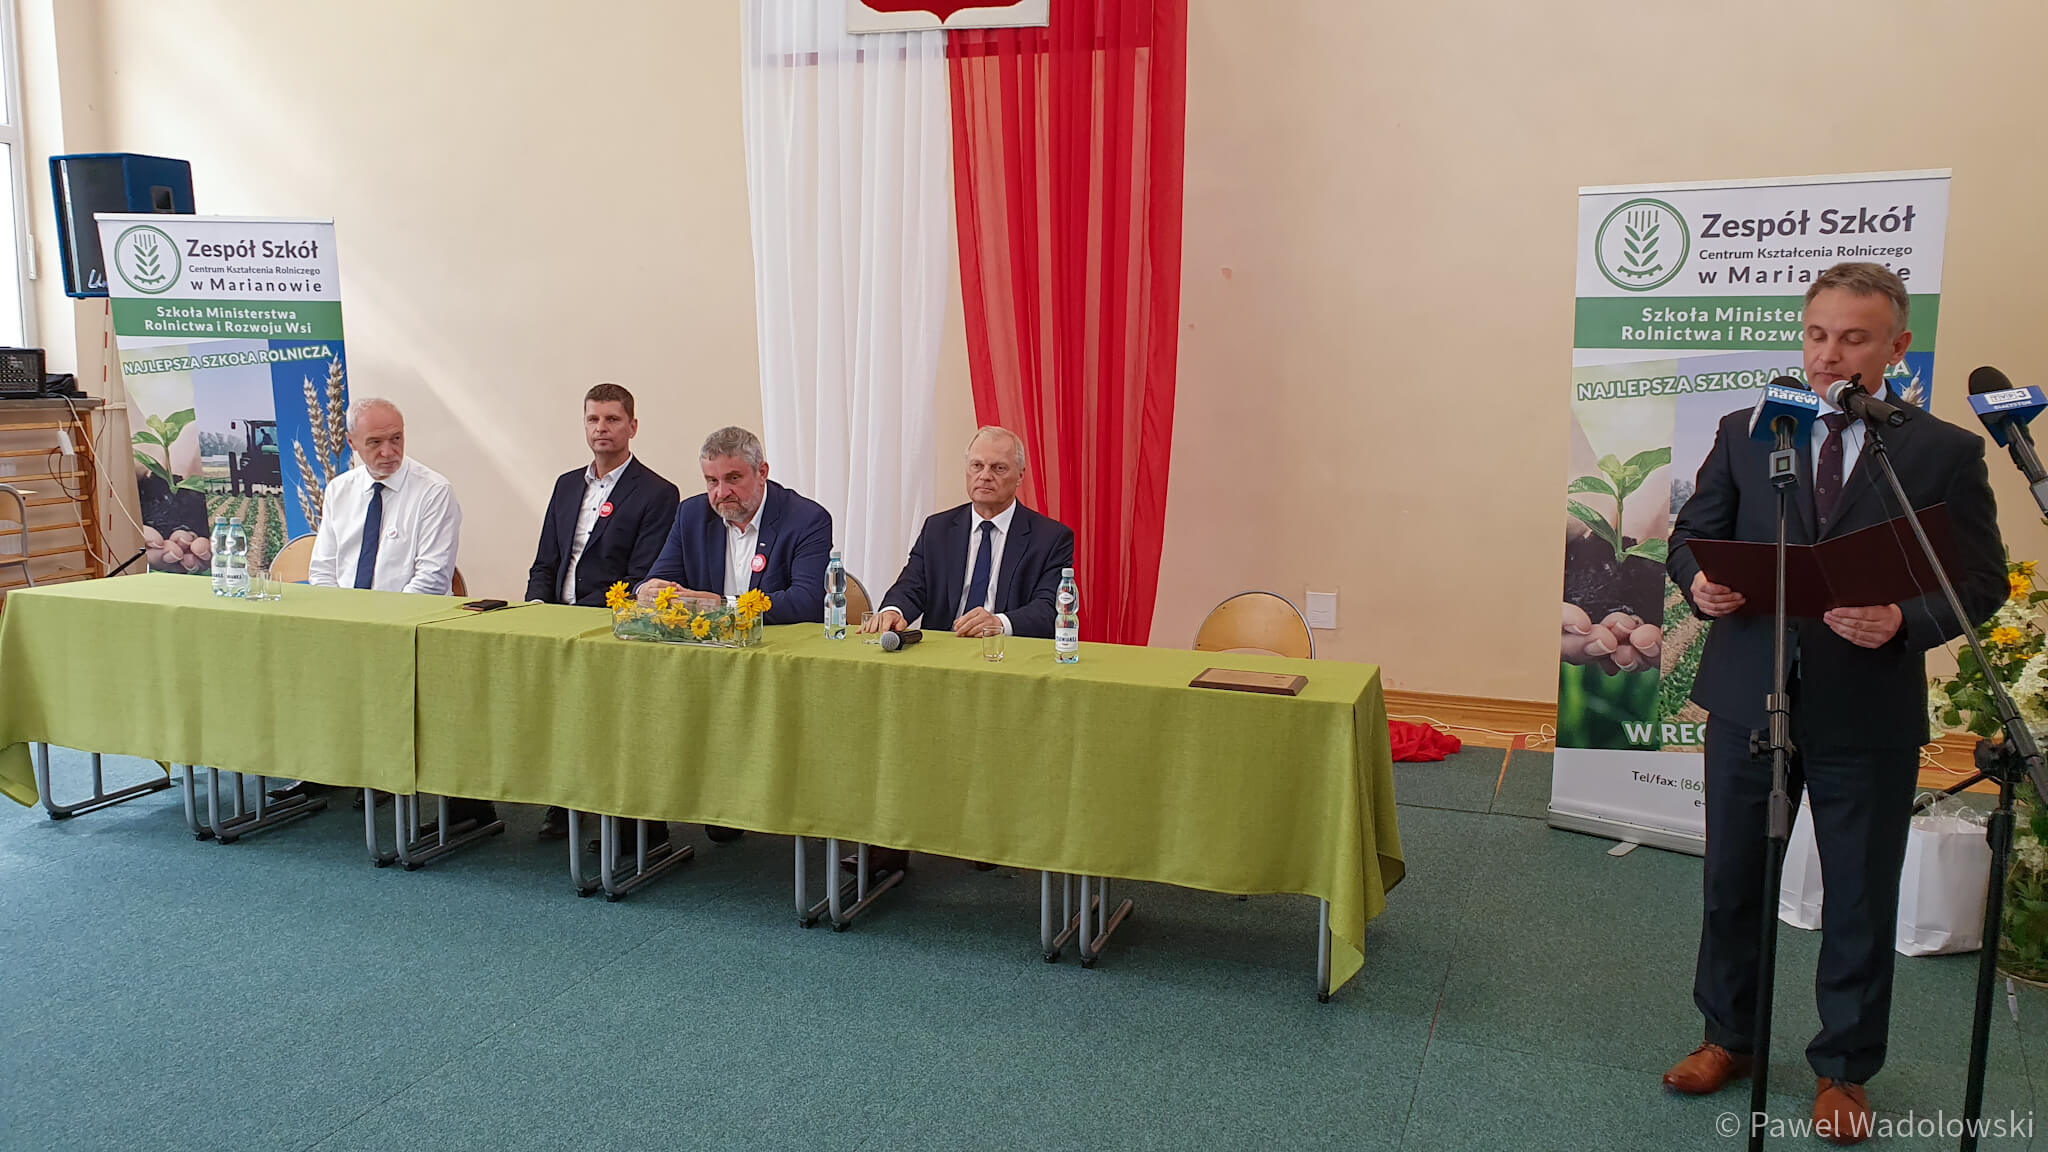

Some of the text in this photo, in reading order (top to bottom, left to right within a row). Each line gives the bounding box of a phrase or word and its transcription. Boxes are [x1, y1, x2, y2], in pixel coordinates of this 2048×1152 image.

[1700, 205, 1916, 242] Zespół Szkół
[186, 239, 318, 261] Zespół Szkół
[1699, 245, 1913, 263] Centrum Kształcenia Rolniczego
[188, 265, 320, 276] Centrum Kształcenia Rolniczego
[1698, 262, 1911, 284] w Mariae
[190, 278, 322, 292] w Marianowie
[156, 306, 296, 320] Szkoła Ministerstwa
[1642, 307, 1709, 322] Szkoła
[144, 320, 312, 335] Rolnictwa i Rozwoju Wsi
[1621, 326, 1722, 341] Rolnictwa
[1728, 326, 1733, 341] i
[123, 345, 332, 374] NAJLEPSZA SZKOŁA ROLNICZA
[1578, 379, 1692, 400] NAJLEPSZA
[1695, 368, 1781, 391] SZKOŁA
[1768, 390, 1818, 405] narew
[1624, 723, 1653, 743] W
[1632, 770, 1705, 793] Tel/fax: (86)
